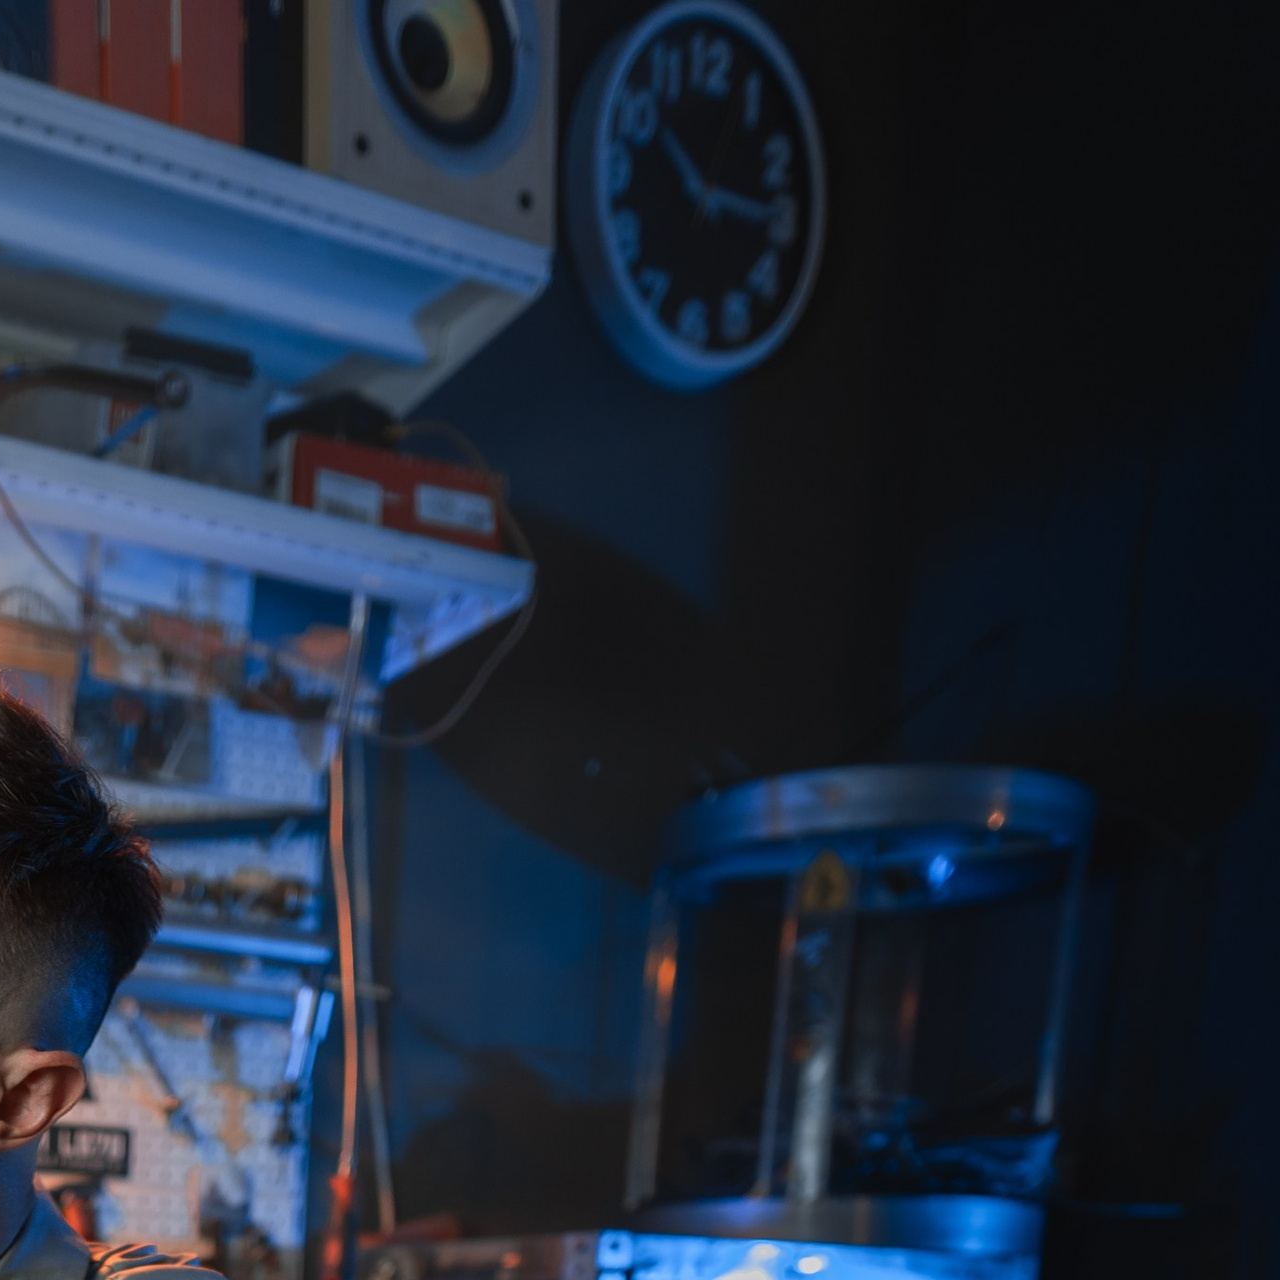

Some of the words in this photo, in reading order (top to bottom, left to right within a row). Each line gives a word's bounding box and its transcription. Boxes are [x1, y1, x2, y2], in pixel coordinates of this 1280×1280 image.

[650, 38, 682, 104] 11
[689, 31, 734, 97] 12
[619, 84, 660, 148] 10
[744, 69, 762, 131] 1
[761, 132, 793, 191] 2
[636, 266, 672, 316] 7
[745, 249, 779, 302] 4
